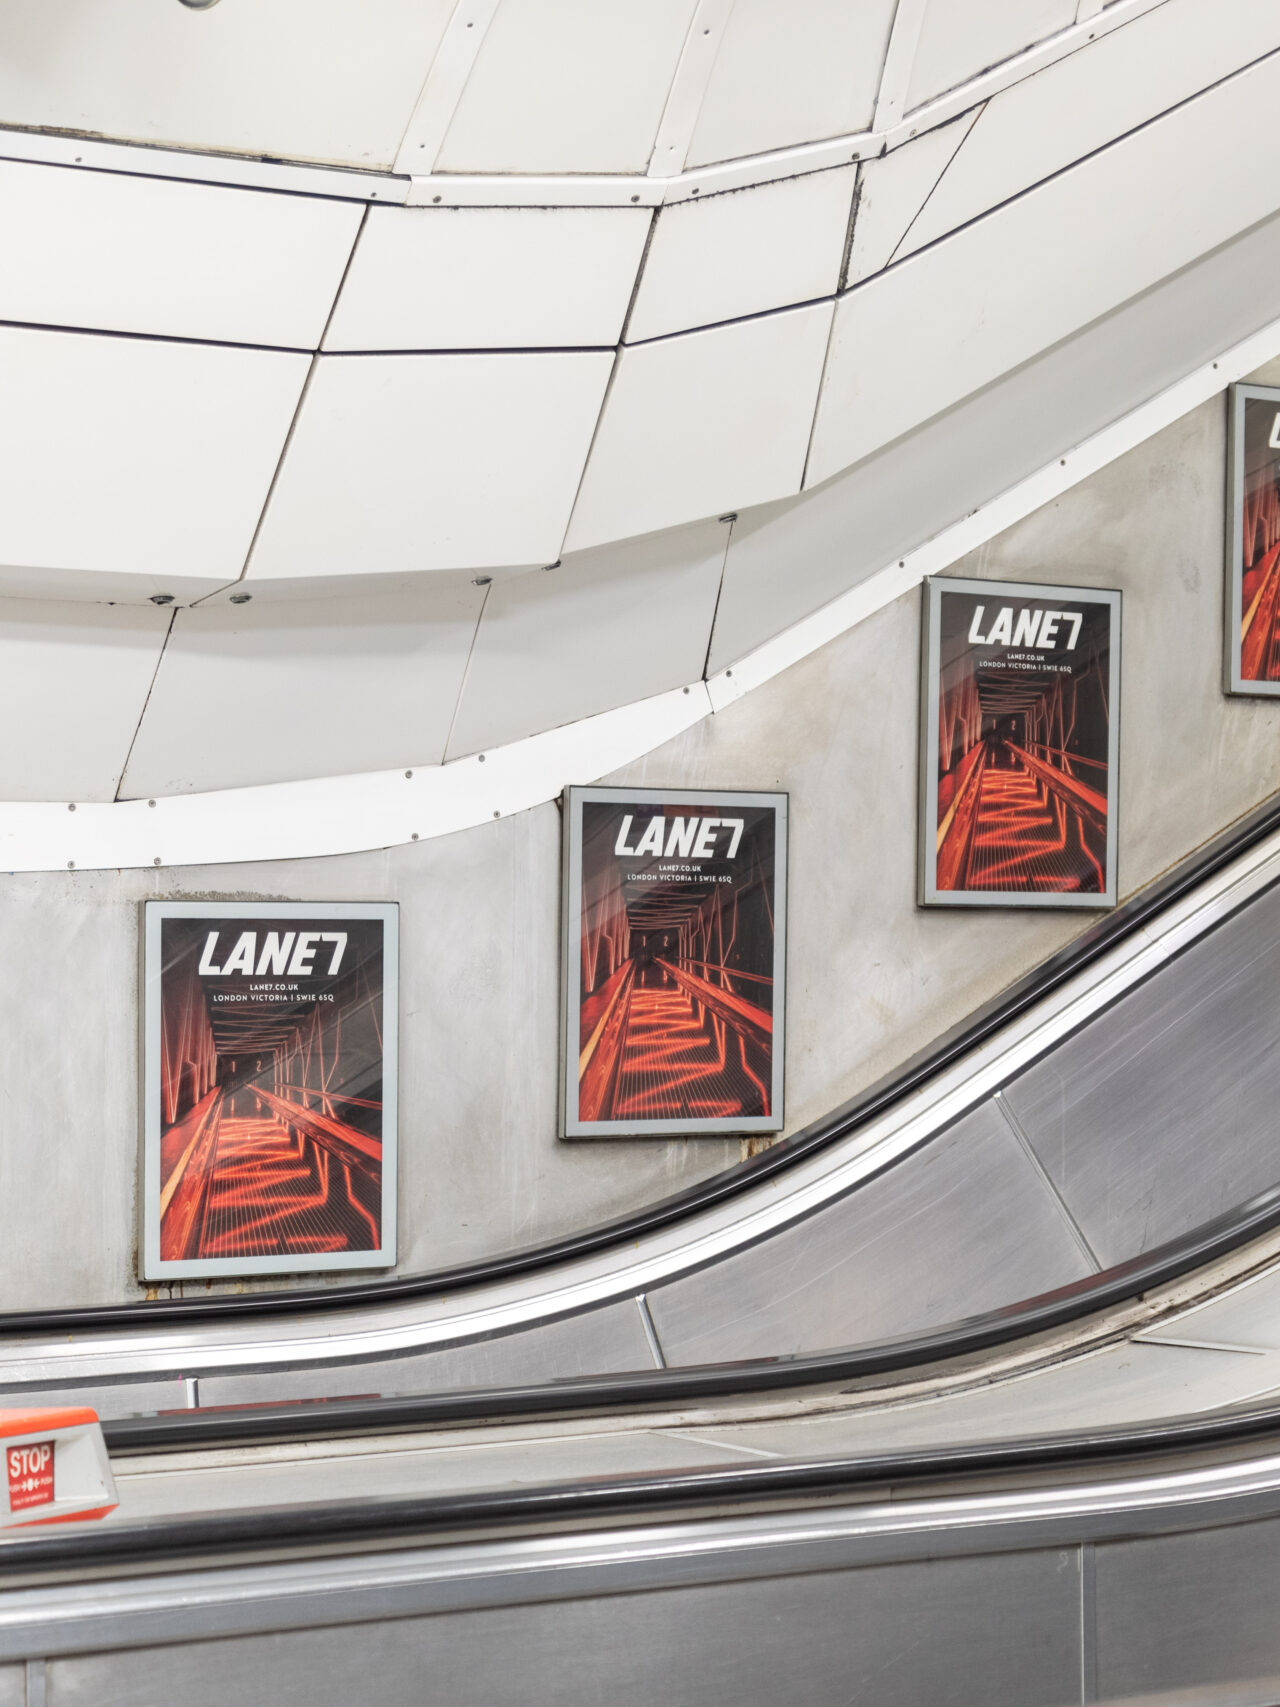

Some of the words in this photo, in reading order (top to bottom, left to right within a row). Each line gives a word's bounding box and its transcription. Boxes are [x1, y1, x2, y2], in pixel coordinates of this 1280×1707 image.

[968, 605, 1083, 650] LANE7
[1007, 653, 1045, 662] LANE7.CO.UK
[614, 814, 745, 859] LANE7
[660, 874, 692, 882] VICTORIA
[718, 876, 732, 884] 6SQ
[198, 931, 348, 976] LANE7
[213, 994, 247, 1002] LONDON
[318, 994, 335, 1002] 6SQ
[10, 1445, 51, 1478] STOP
